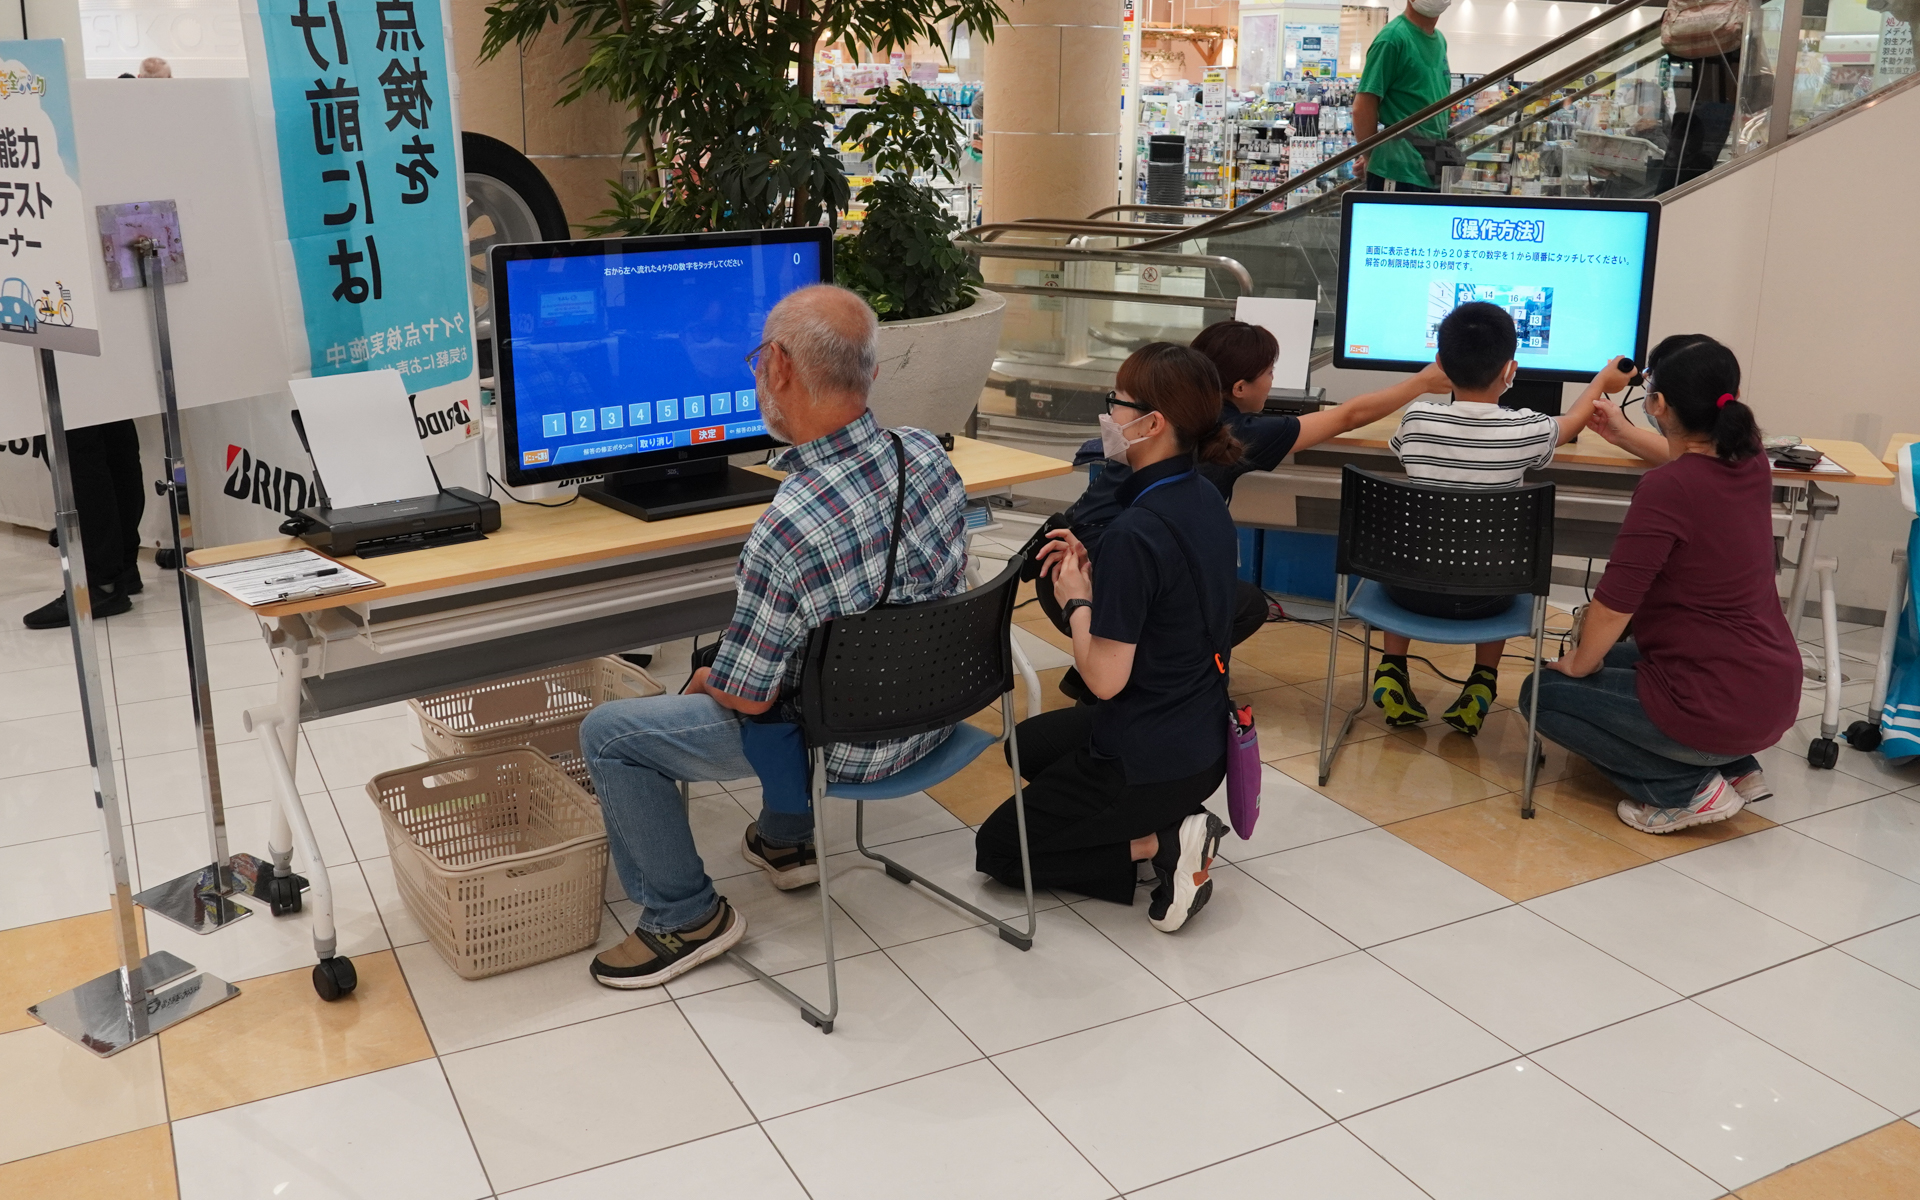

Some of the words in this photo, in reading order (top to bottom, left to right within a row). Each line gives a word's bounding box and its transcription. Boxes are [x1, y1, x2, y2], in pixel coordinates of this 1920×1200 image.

[1452, 217, 1544, 243] 【操作方法】
[793, 252, 801, 265] 0
[604, 259, 743, 276] 右から左へ流れた4ケタの数字をタッチしてください
[718, 398, 725, 410] 7
[742, 396, 749, 406] 8
[665, 405, 672, 417] 5
[691, 402, 698, 414] 6
[608, 412, 615, 424] 3
[637, 409, 645, 420] 4
[552, 419, 558, 431] 1
[580, 416, 587, 428] 2
[699, 429, 717, 440] 決定
[640, 436, 672, 449] 取り消し
